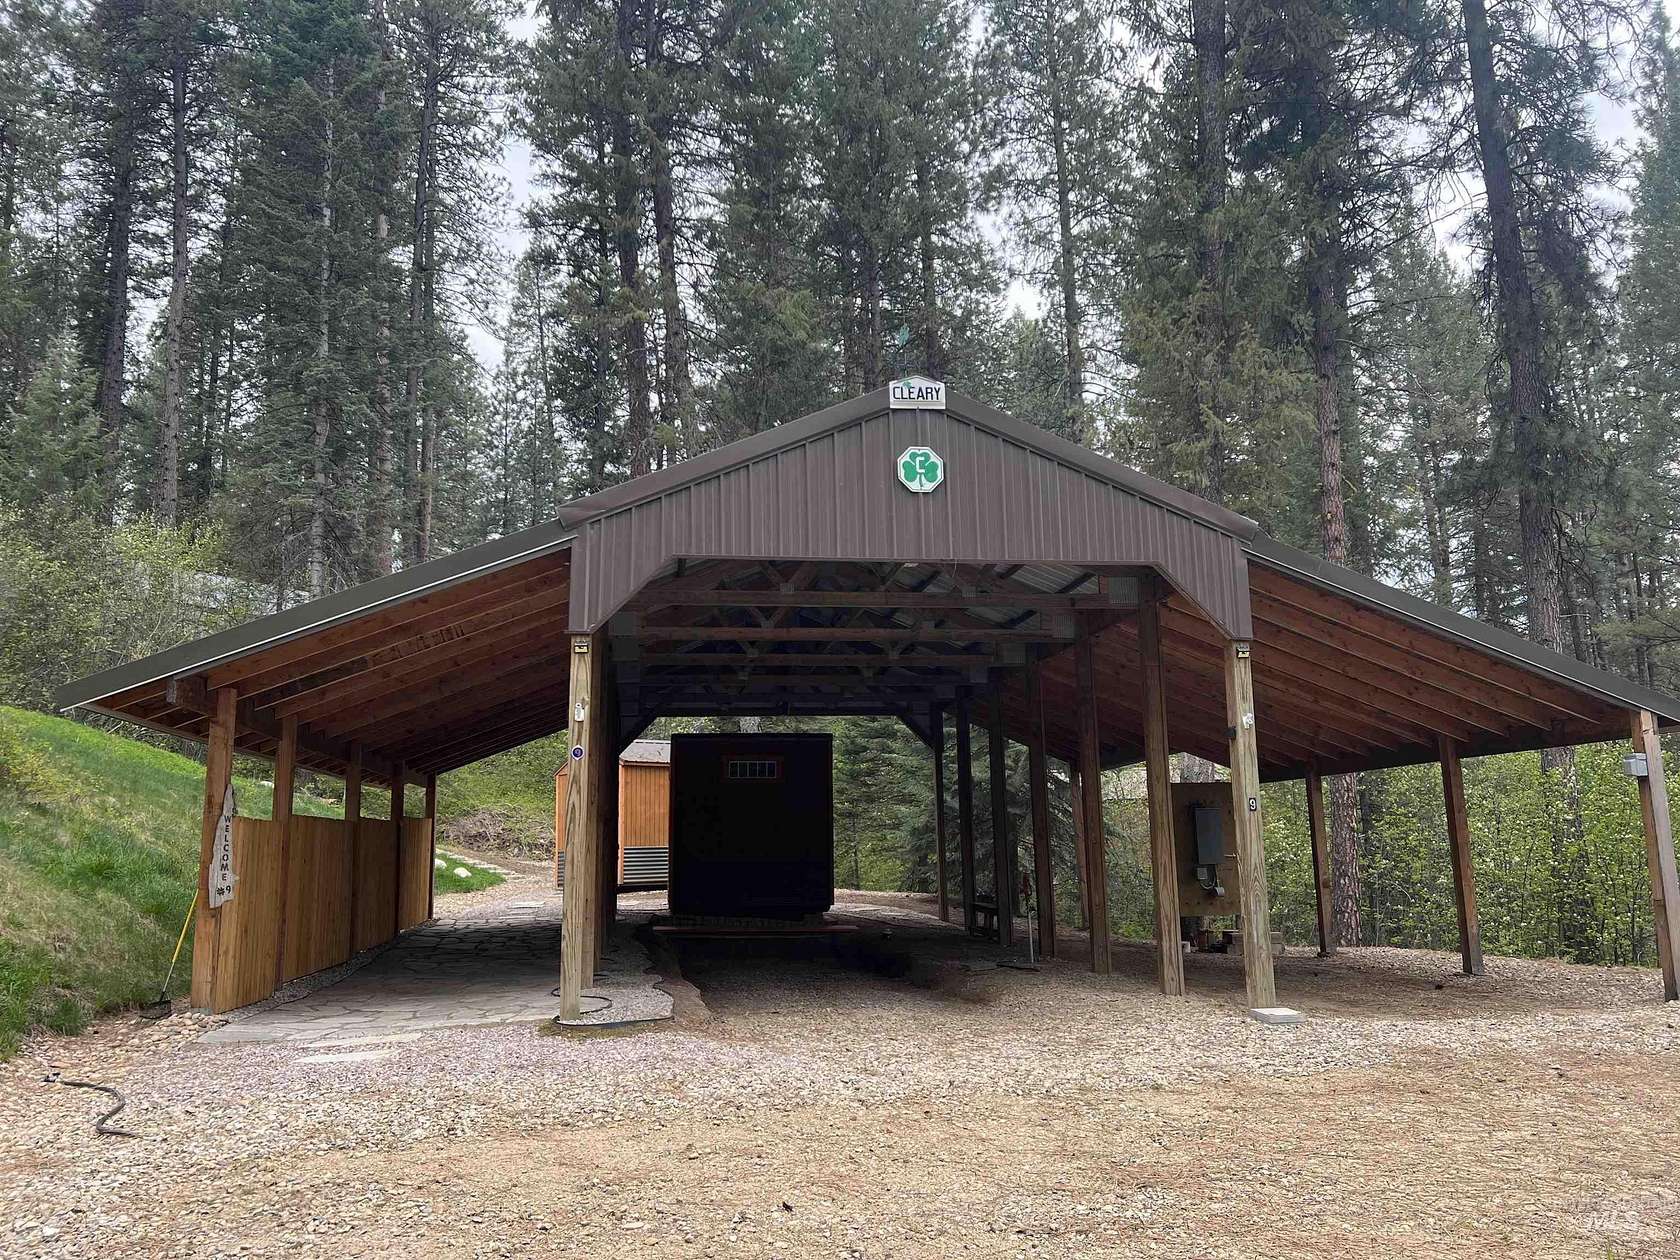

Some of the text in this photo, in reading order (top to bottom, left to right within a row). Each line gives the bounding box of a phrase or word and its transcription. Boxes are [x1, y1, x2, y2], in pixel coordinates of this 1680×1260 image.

[892, 386, 941, 400] CLEARY
[915, 456, 926, 473] C
[1249, 798, 1256, 810] 9
[220, 815, 232, 881] WELCOME
[216, 885, 231, 896] #9
